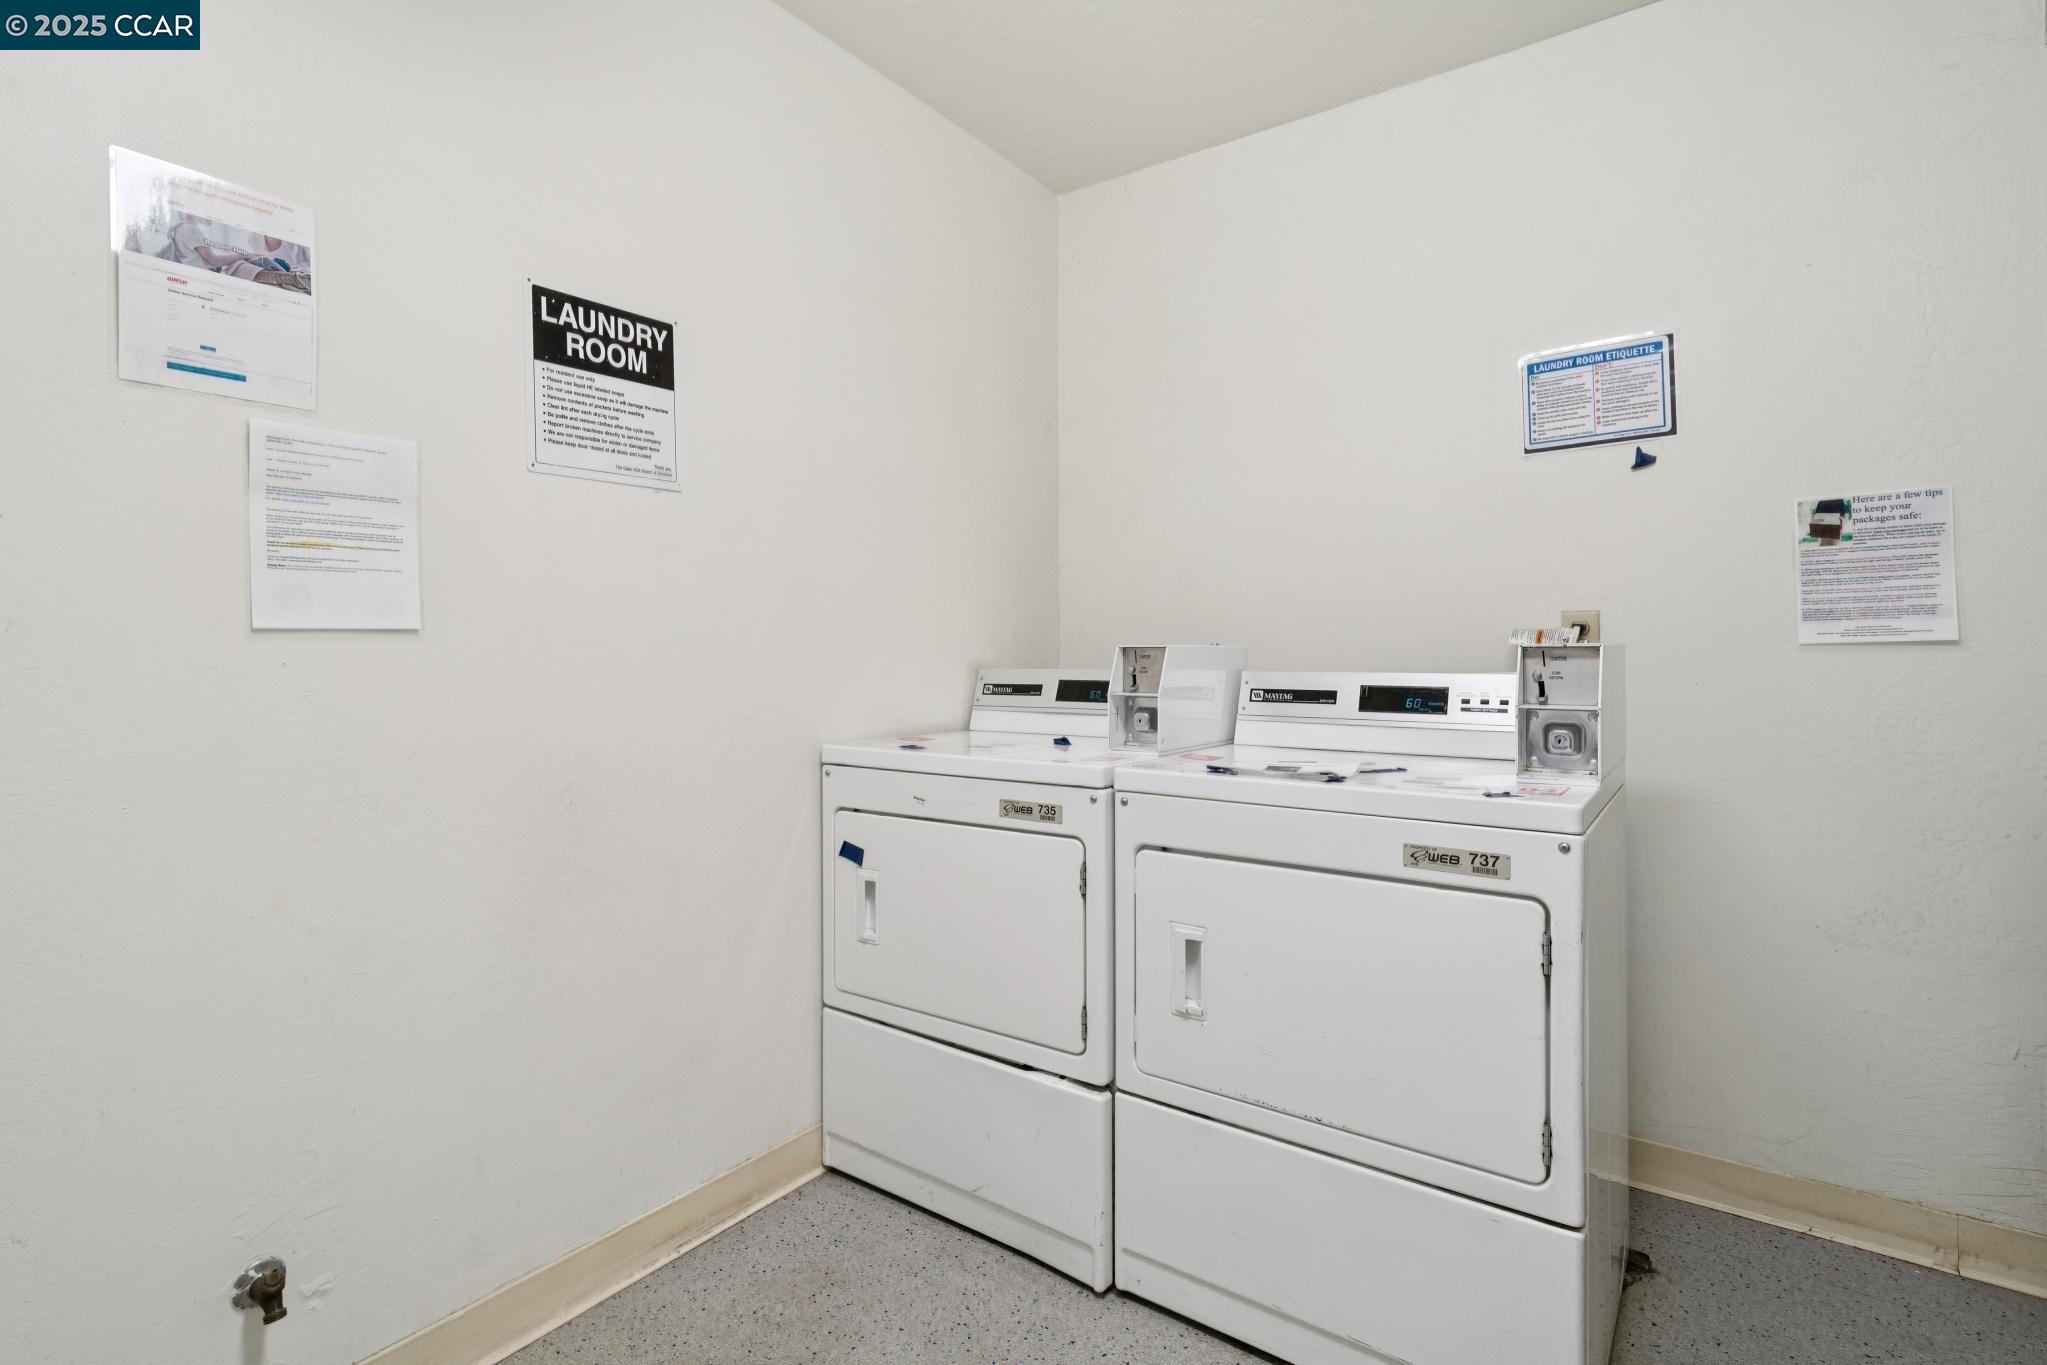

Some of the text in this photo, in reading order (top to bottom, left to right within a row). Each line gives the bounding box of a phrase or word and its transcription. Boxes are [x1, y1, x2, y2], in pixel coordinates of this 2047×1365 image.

[540, 295, 668, 351] LAUNDRY
[566, 331, 648, 374] ROOM
[1534, 344, 1656, 374] LAUNDRY ROOM ETIQUETTE
[547, 376, 562, 384] Please
[556, 370, 574, 378] resident
[547, 394, 566, 402] Remove
[567, 398, 587, 406] contents
[597, 420, 613, 428] clothes
[605, 430, 620, 438] directly
[643, 438, 661, 446] company
[1852, 496, 1875, 504] Here
[1878, 494, 1893, 502] are
[1904, 491, 1922, 499] few
[1925, 489, 1943, 498] tips
[1864, 505, 1887, 513] keep
[1890, 503, 1912, 512] your
[1853, 512, 1922, 525] packages safe:
[1090, 690, 1101, 698] 60
[1264, 692, 1293, 700] MAYTAG
[1406, 698, 1421, 708] 60
[1013, 804, 1056, 816] WEB 735
[1428, 852, 1500, 868] WEB 737
